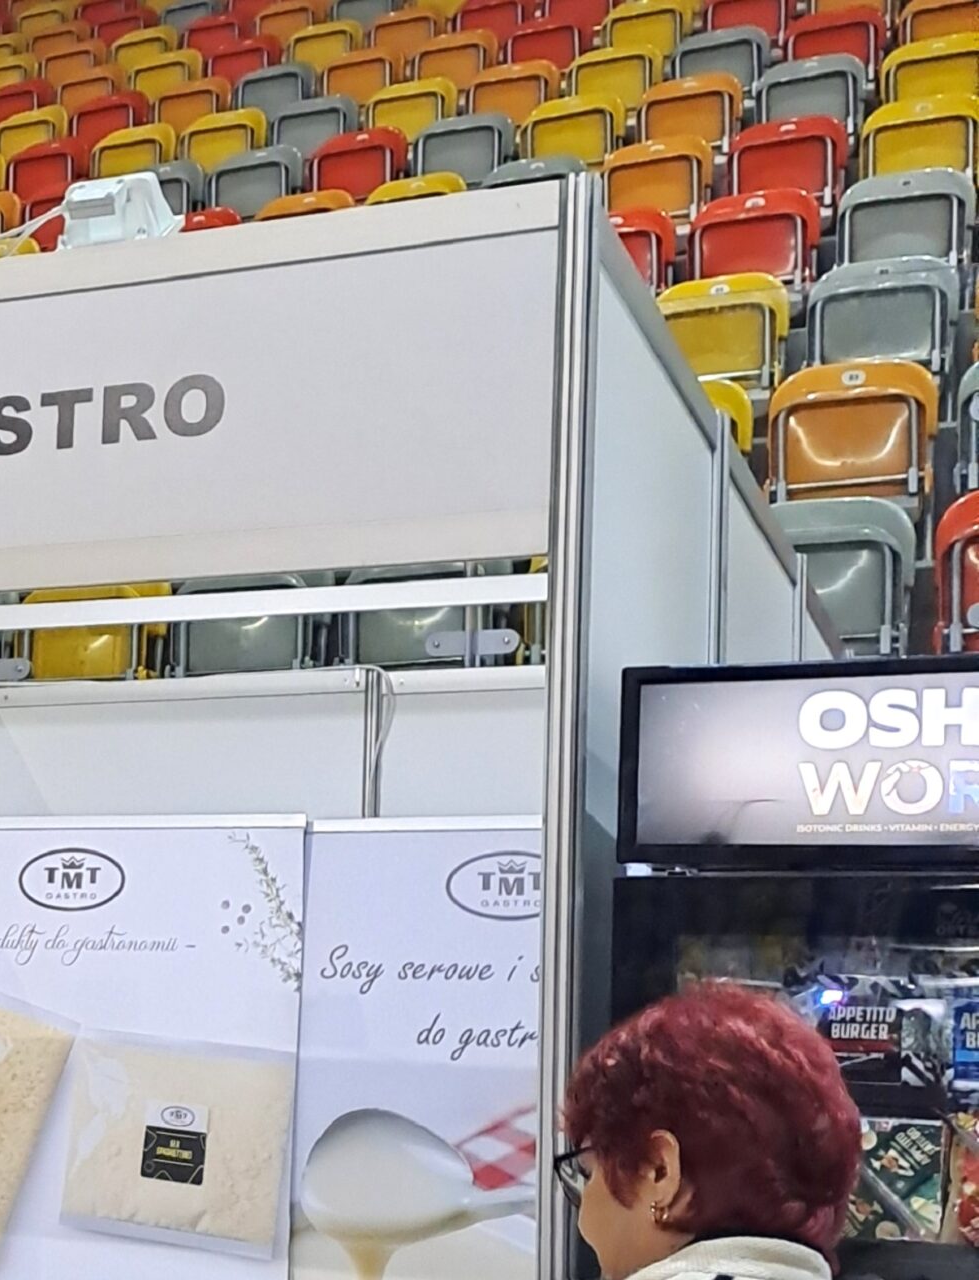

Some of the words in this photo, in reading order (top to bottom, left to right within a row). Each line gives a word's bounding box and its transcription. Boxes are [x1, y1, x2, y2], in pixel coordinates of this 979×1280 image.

[798, 687, 979, 750] OSH
[796, 823, 843, 833] ISOTONIC
[845, 823, 882, 832] DRINKS
[889, 823, 933, 832] VITAMIN
[940, 823, 979, 832] ENERGY
[44, 866, 101, 890] TMT
[477, 871, 541, 897] TMT
[45, 892, 98, 900] GASTRO
[44, 924, 70, 951] do
[61, 924, 178, 966] gastronomii
[320, 944, 385, 995] Sosy
[398, 961, 495, 982] serowe
[507, 955, 524, 982] i
[828, 1006, 897, 1023] APPETITO
[416, 1012, 446, 1046] do
[450, 1020, 540, 1062] gastr
[831, 1023, 890, 1040] BURGER
[966, 1031, 979, 1048] B
